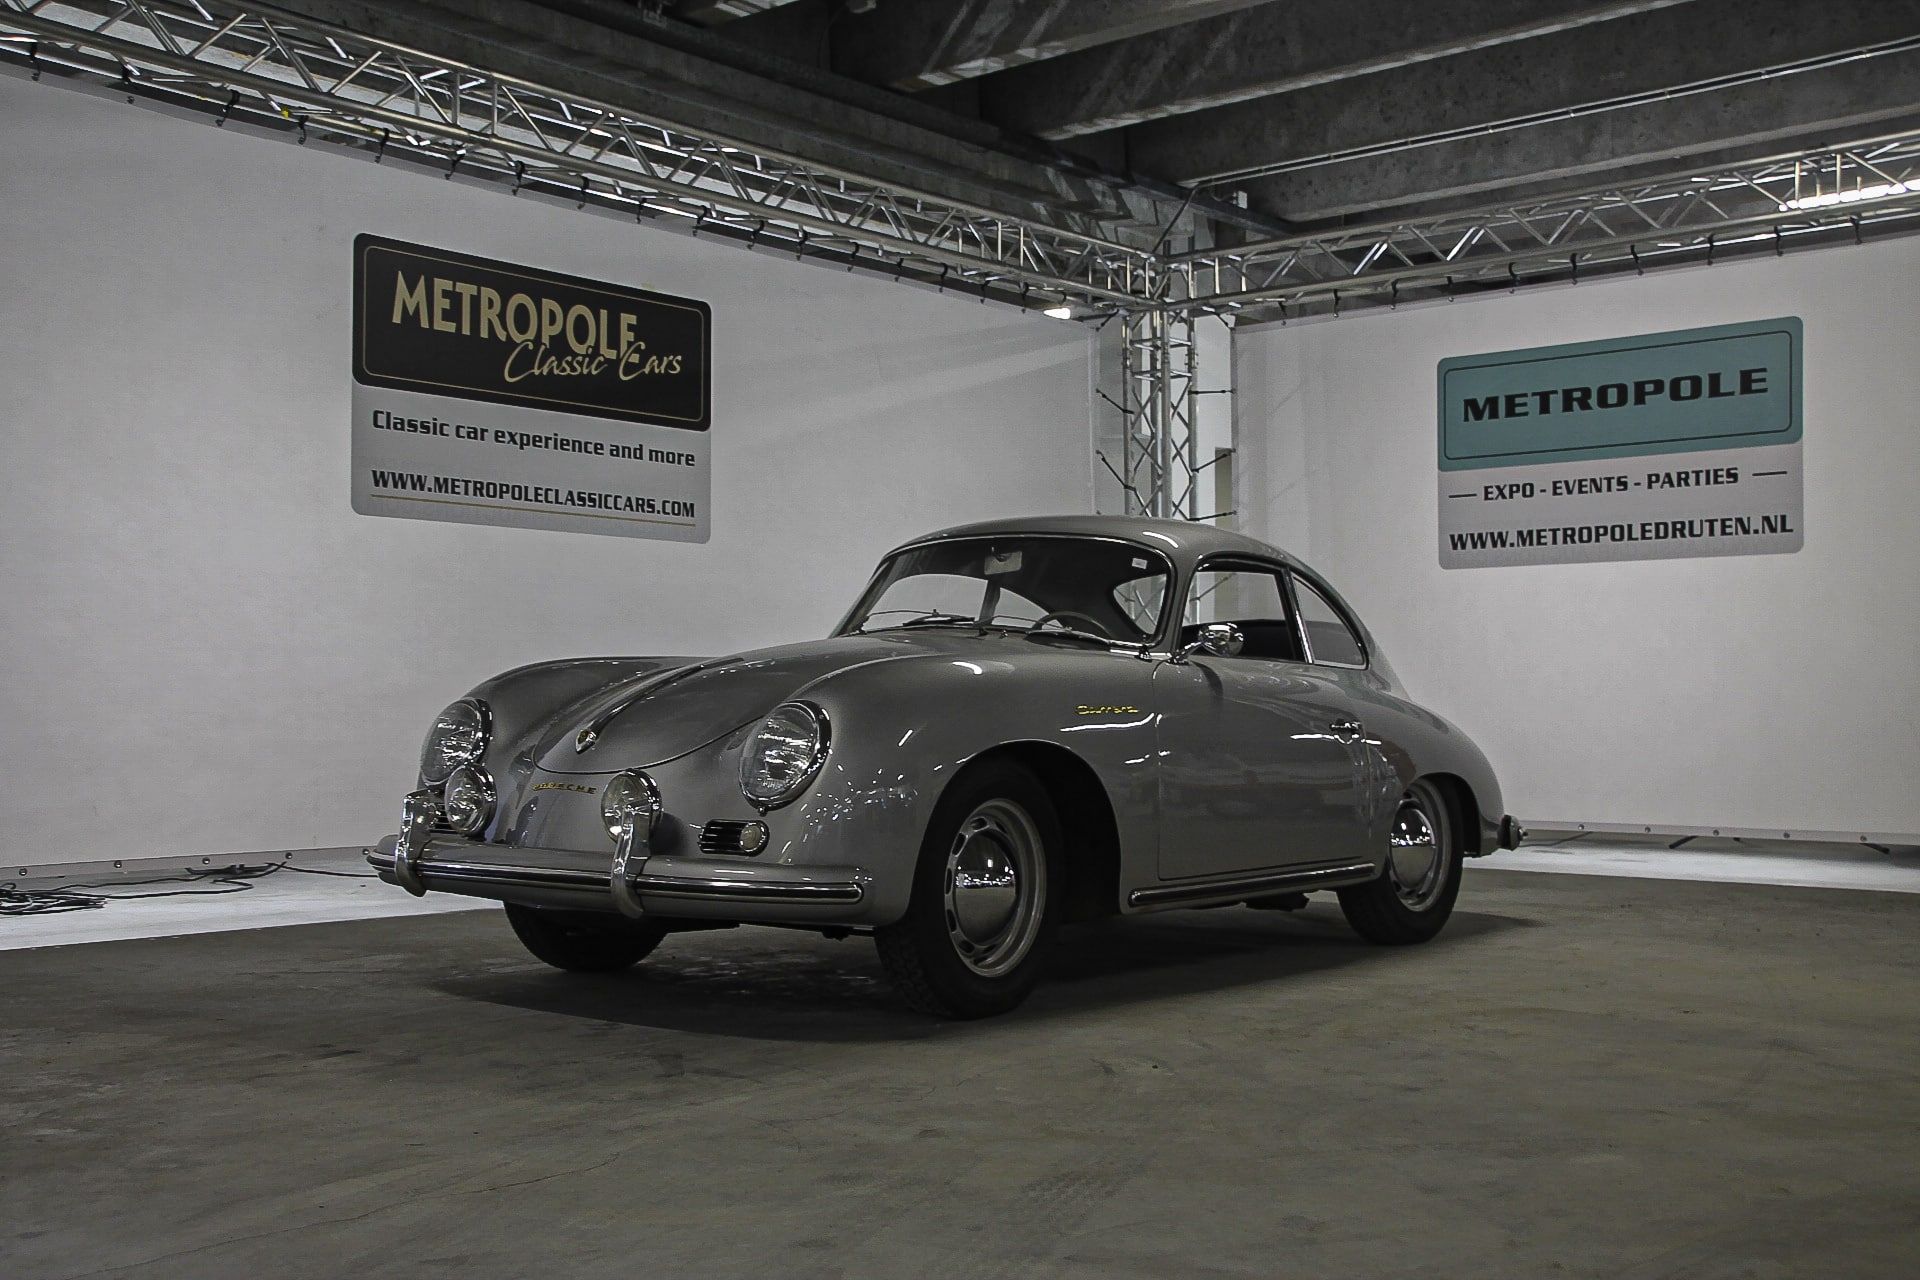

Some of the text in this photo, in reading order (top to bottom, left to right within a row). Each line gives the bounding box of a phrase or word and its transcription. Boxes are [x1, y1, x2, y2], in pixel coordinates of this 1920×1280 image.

[392, 270, 640, 364] METROPOLE
[504, 341, 682, 383] Classic Cars
[1463, 367, 1769, 423] METROPOLE
[372, 409, 696, 467] Classic car experience and more
[371, 469, 696, 518] WWW.METROPOLECLASSICCARS.COM
[1483, 482, 1535, 501] EXPO
[1552, 475, 1628, 496] EVENTS
[1647, 467, 1739, 490] PARTIES
[1449, 514, 1794, 551] WWW.METROPOLEDRUTEN.NL
